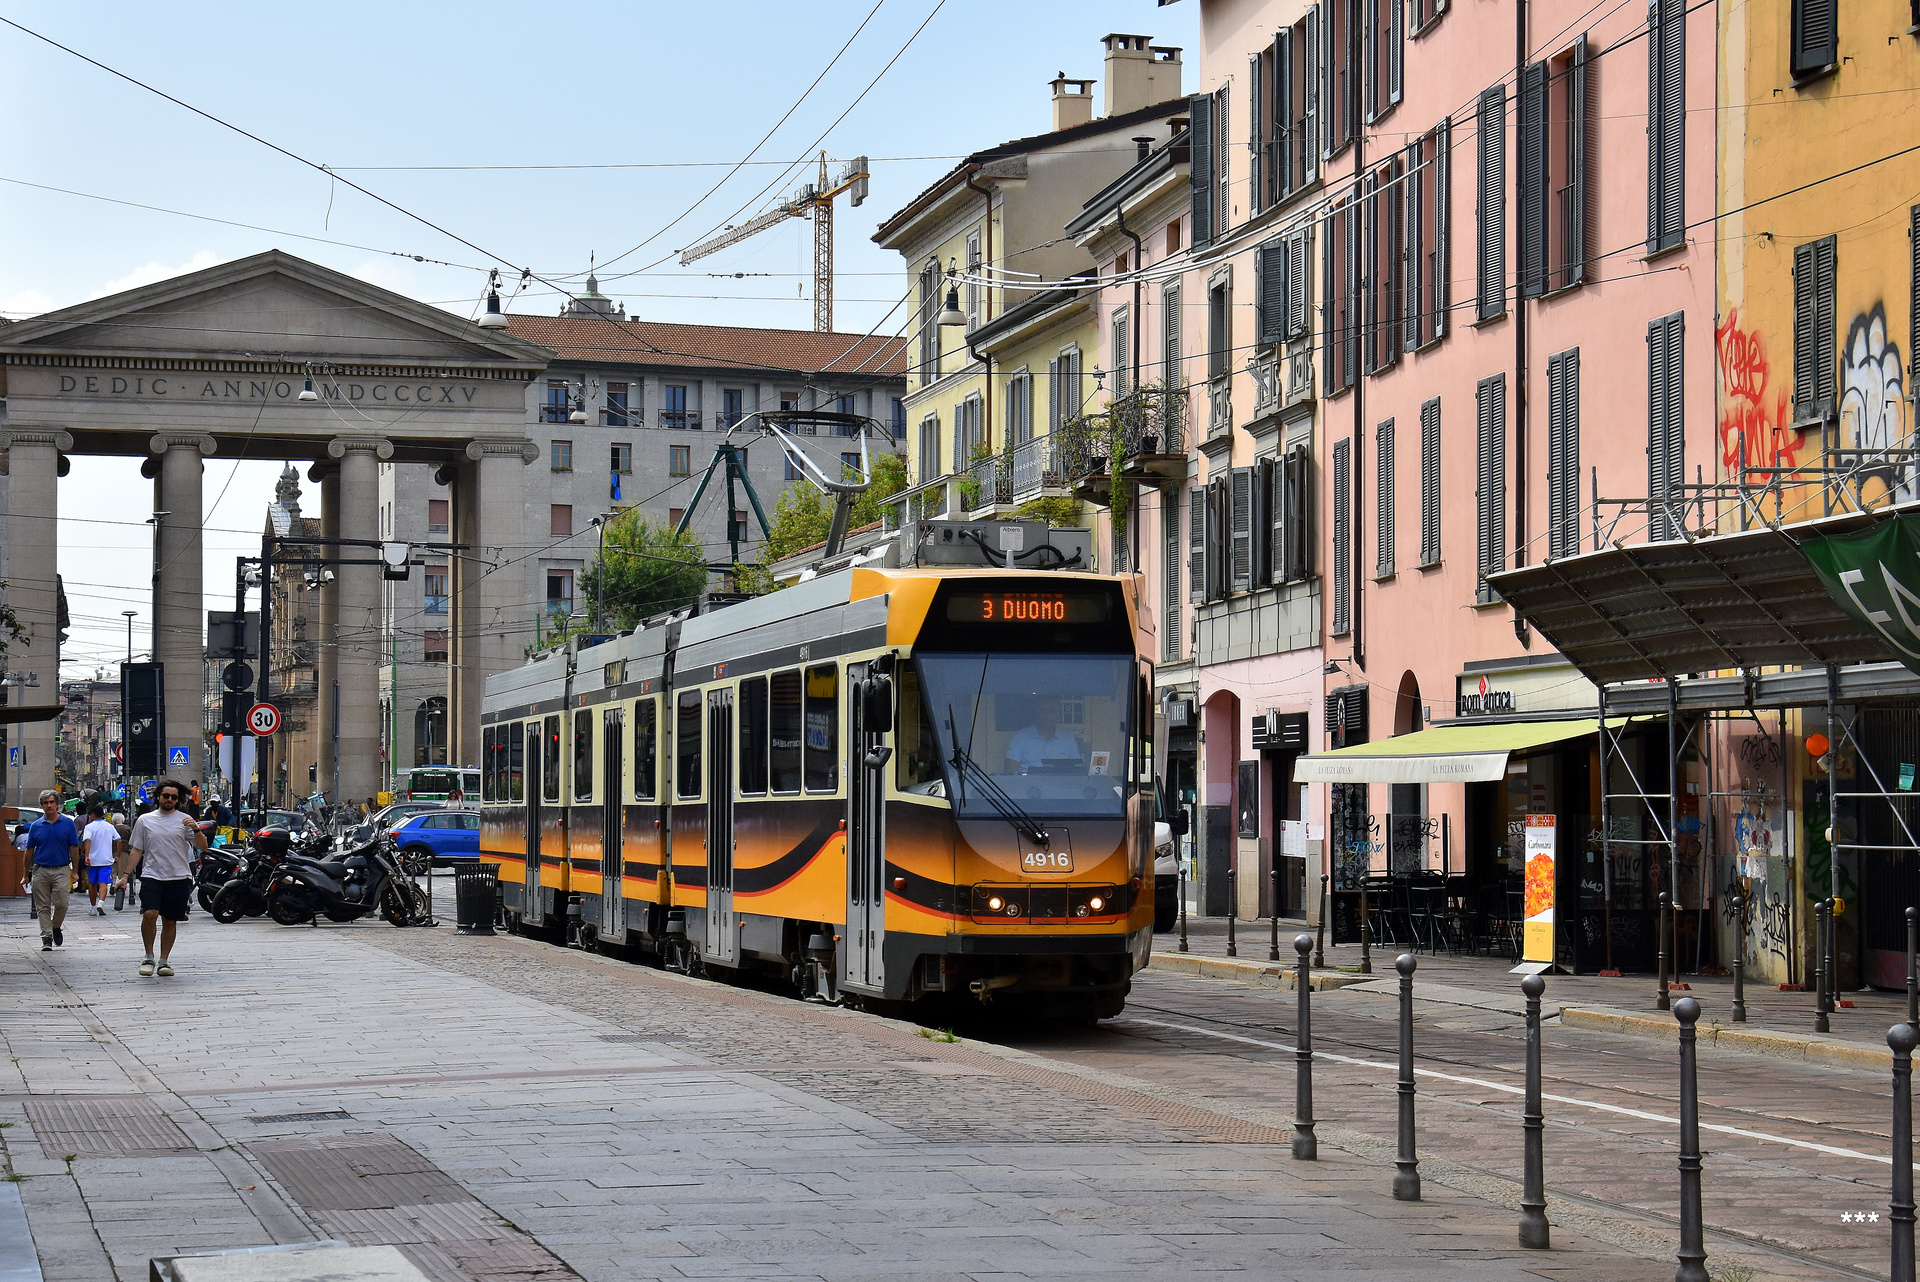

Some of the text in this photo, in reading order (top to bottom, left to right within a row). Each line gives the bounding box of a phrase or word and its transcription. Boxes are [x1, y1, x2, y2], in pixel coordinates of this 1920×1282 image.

[60, 376, 477, 402] DEDIC ANNO MDCCCXV
[983, 600, 1063, 619] 3 DUOMO
[254, 711, 273, 727] 30
[1097, 757, 1103, 766] 6
[1095, 767, 1101, 775] 3
[1024, 852, 1069, 867] 4916
